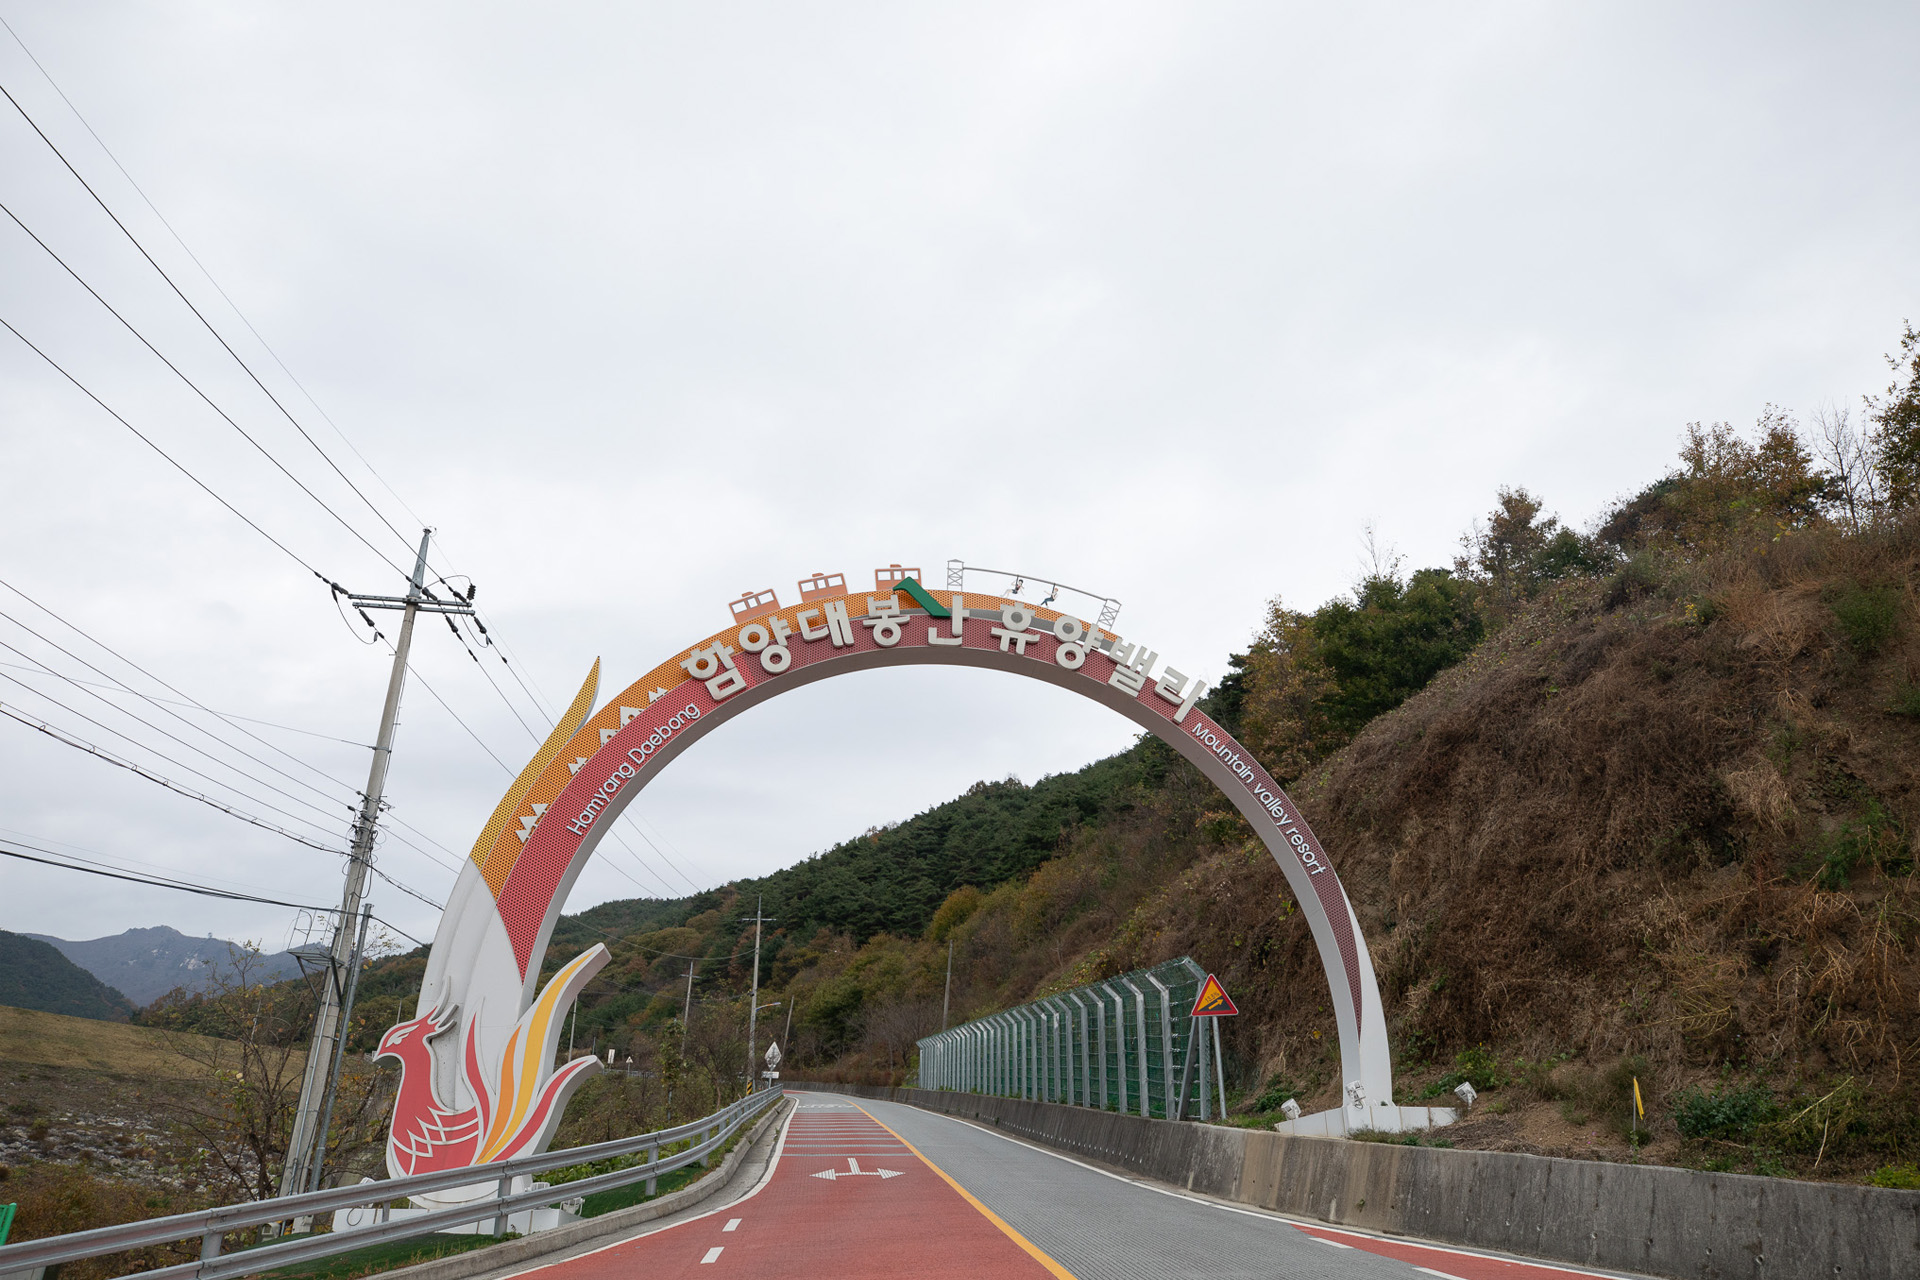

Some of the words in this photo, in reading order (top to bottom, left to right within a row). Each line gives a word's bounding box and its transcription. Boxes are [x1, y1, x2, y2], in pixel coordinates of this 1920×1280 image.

[566, 761, 635, 836] Hamyang
[627, 702, 701, 765] Daebong
[1191, 722, 1255, 784] Mountain
[1253, 783, 1292, 827] valley
[1285, 827, 1327, 875] resort
